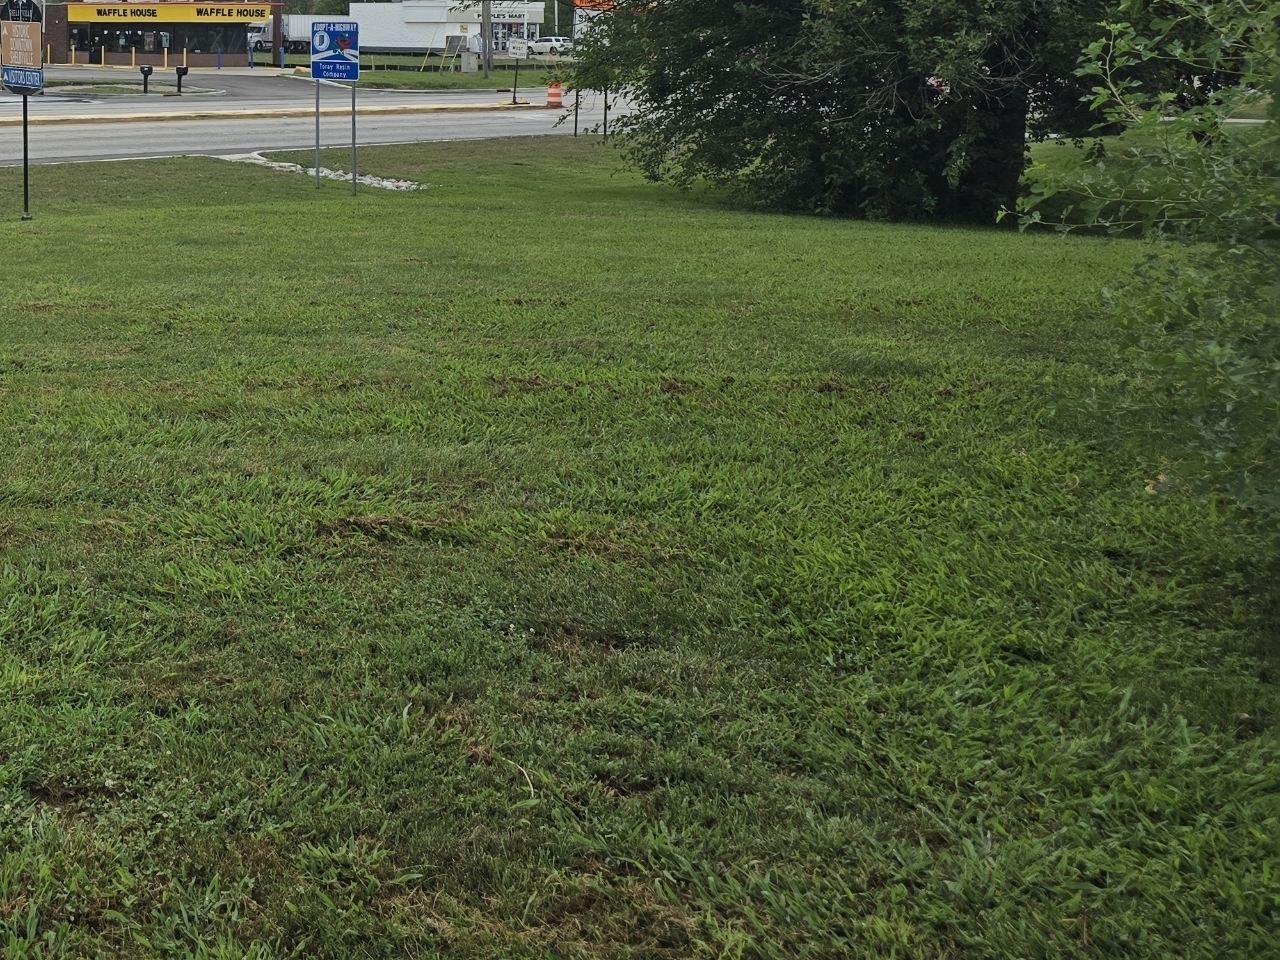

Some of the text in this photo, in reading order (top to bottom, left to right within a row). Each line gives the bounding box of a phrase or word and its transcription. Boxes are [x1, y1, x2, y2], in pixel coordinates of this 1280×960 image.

[96, 8, 157, 18] WAFFLE HOUSE
[196, 7, 266, 18] WAFFLE HOUSE
[12, 25, 30, 38] HISTORIC
[313, 23, 357, 32] ADOPT-A-HIGHWAY
[10, 38, 33, 51] DOWNTOWN
[10, 51, 34, 65] SHELBYVILLE
[319, 63, 333, 71] Toray
[8, 69, 40, 85] VISITORS CENTER
[322, 70, 347, 78] Company
